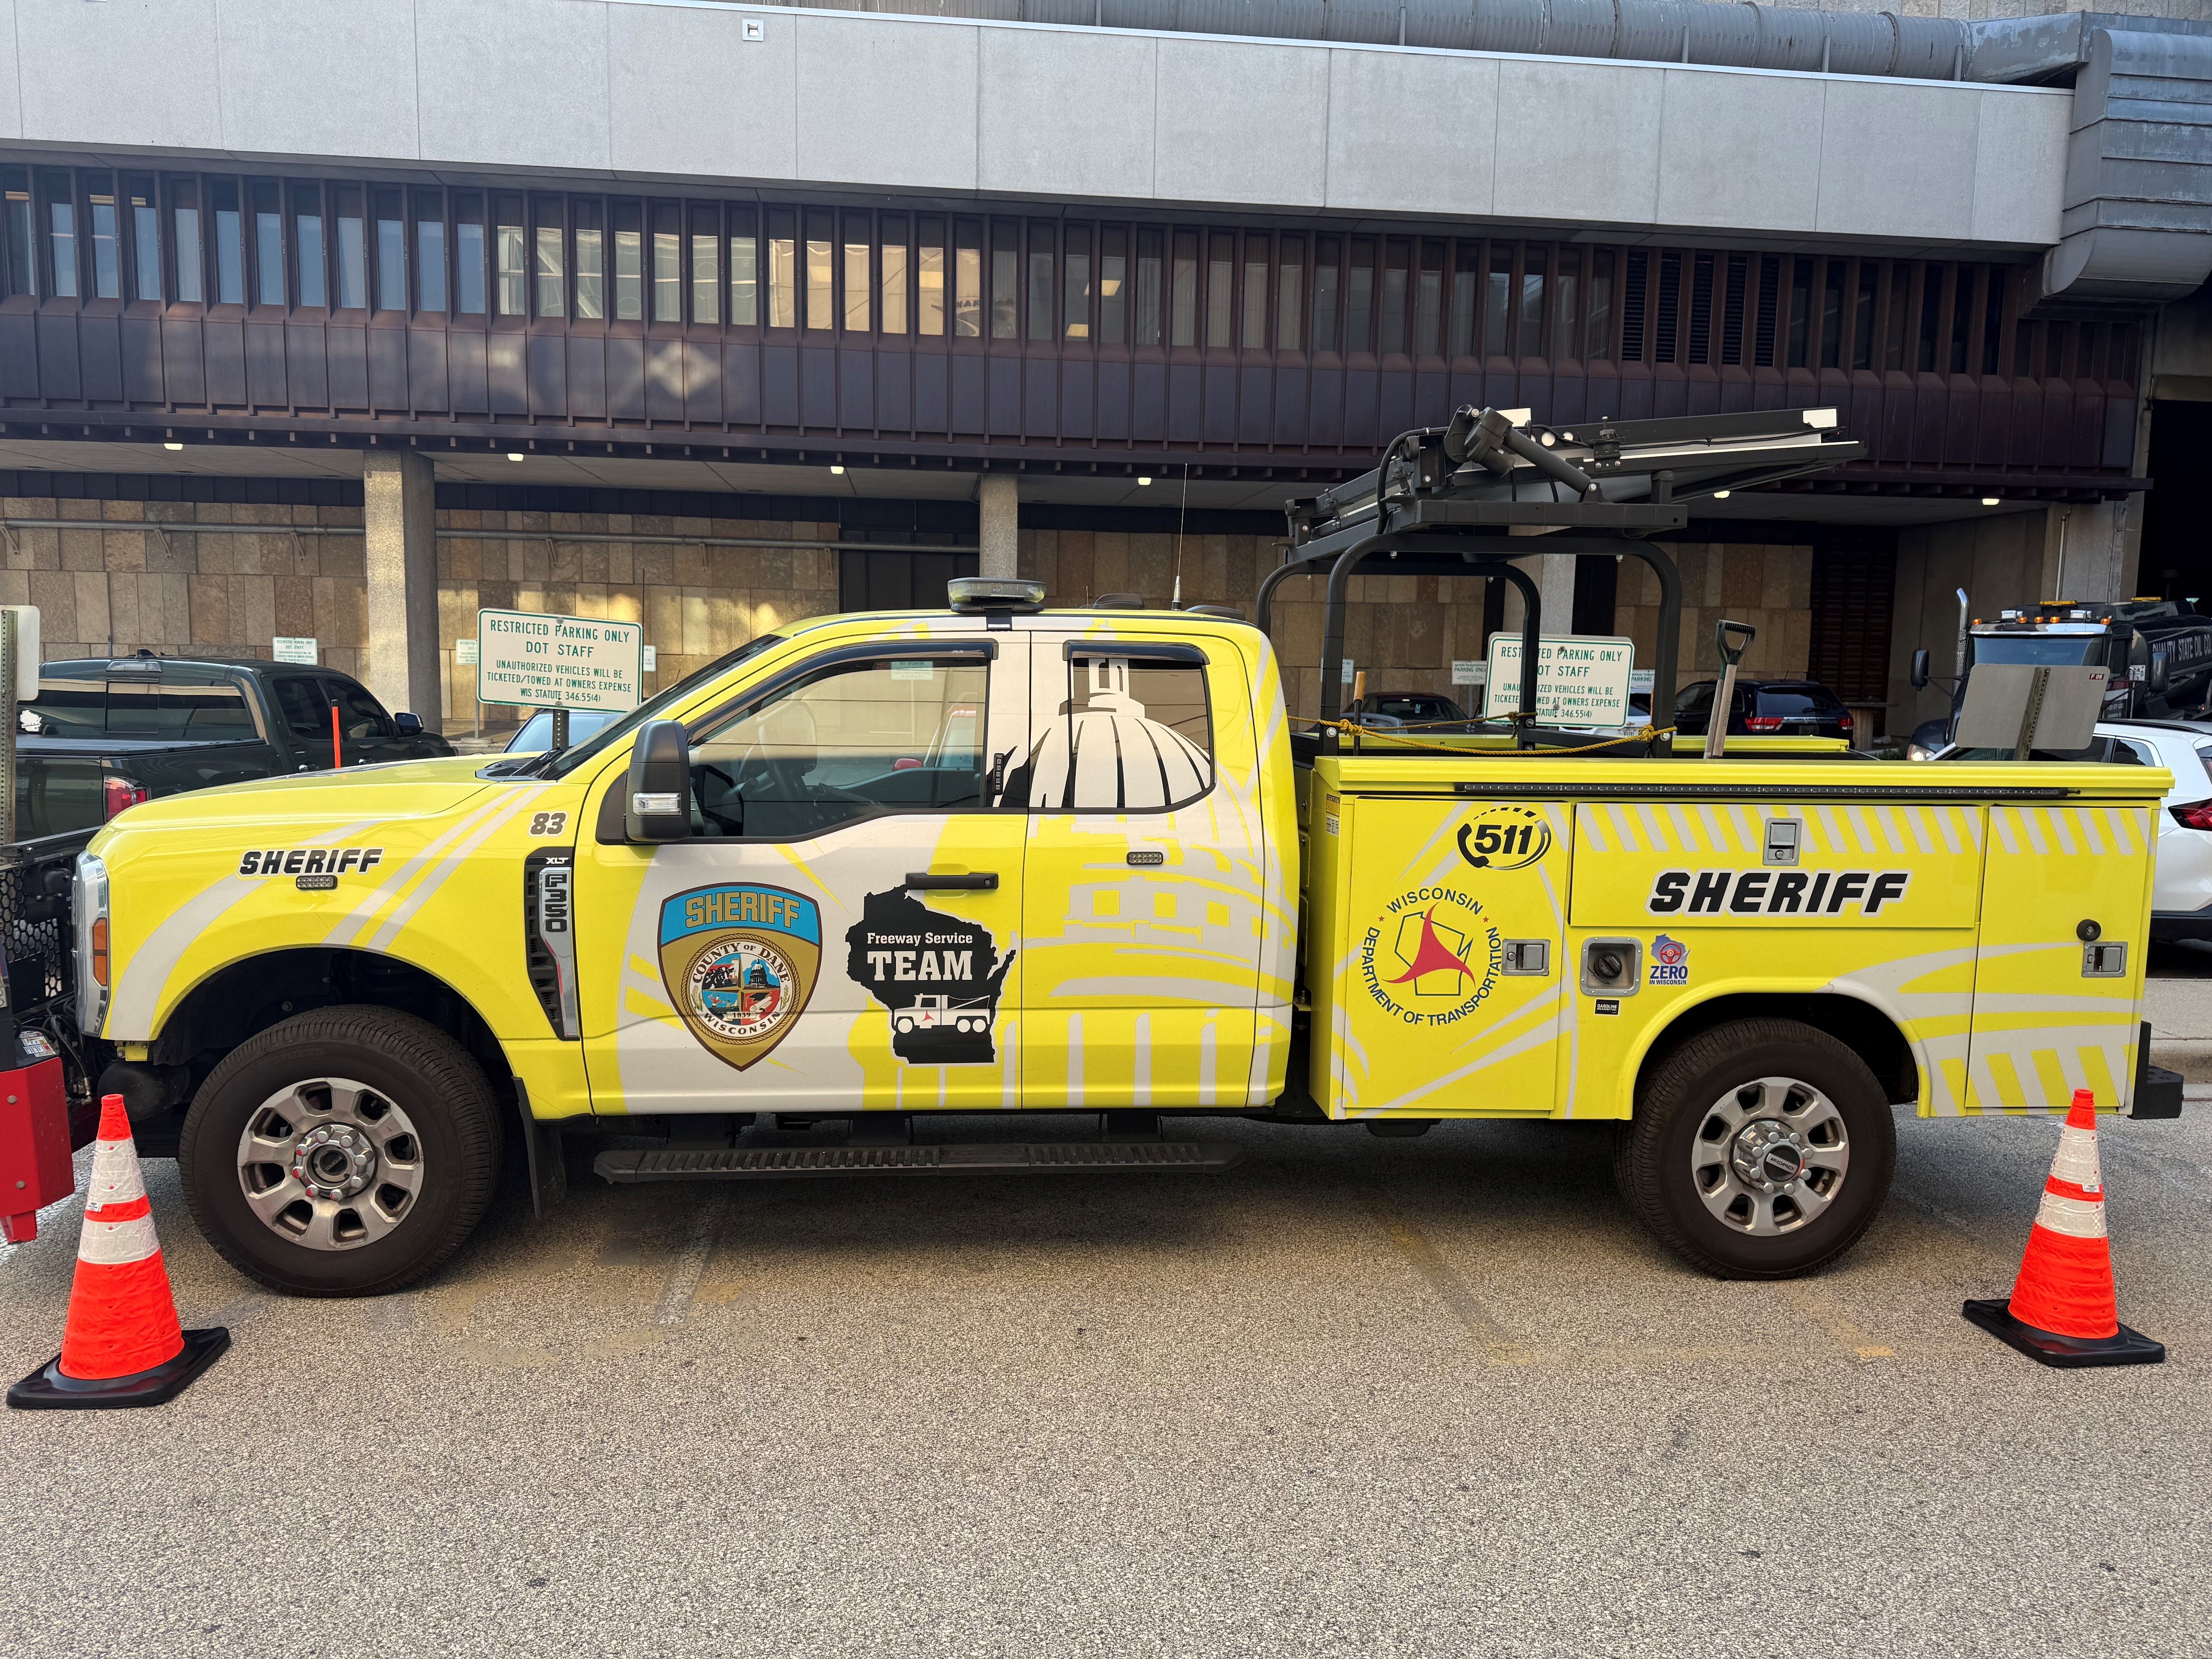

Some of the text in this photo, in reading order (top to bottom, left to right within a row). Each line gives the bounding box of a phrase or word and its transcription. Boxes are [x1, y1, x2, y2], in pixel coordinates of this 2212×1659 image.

[491, 620, 629, 643] RESTRICTED PARKING ONLY
[526, 641, 594, 658] DOT STAFF
[1501, 646, 1623, 662] RESTTED PARKING ONLY
[2178, 637, 2193, 661] STATE
[496, 659, 623, 678] UNAUTHORIZED VEHICLES WILL BE
[1537, 665, 1590, 677] OT STAFF
[487, 672, 632, 692] TICKETED/TOWED AT OWNERS EXPENSE
[1503, 683, 1613, 696] UNAUIZED VEHICLES WILL BE
[520, 688, 601, 702] WIS STATUTE 346.55(4)
[1494, 694, 1620, 708] TICKETEWED AT OWNERS EXPENSE
[1561, 709, 1592, 718] 346.55(4)
[530, 812, 567, 835] 83
[1474, 824, 1534, 855] 511
[239, 849, 383, 875] SHERIFF
[1386, 887, 1484, 915] WISCONSIN
[1649, 872, 1908, 913] SHERIFF
[685, 891, 800, 928] SHERIFF
[867, 932, 973, 946] Freeway Service
[692, 942, 741, 984] COUNTY
[758, 946, 790, 982] DANE
[867, 951, 973, 981] TEAM
[1650, 965, 1688, 979] ZERO
[1361, 926, 1502, 1026] DEPARTMENT OF TRANSPORTATION
[703, 1011, 781, 1035] WISCONSIN
[325, 1156, 342, 1170] FORD
[1770, 1158, 1794, 1171] FORD
